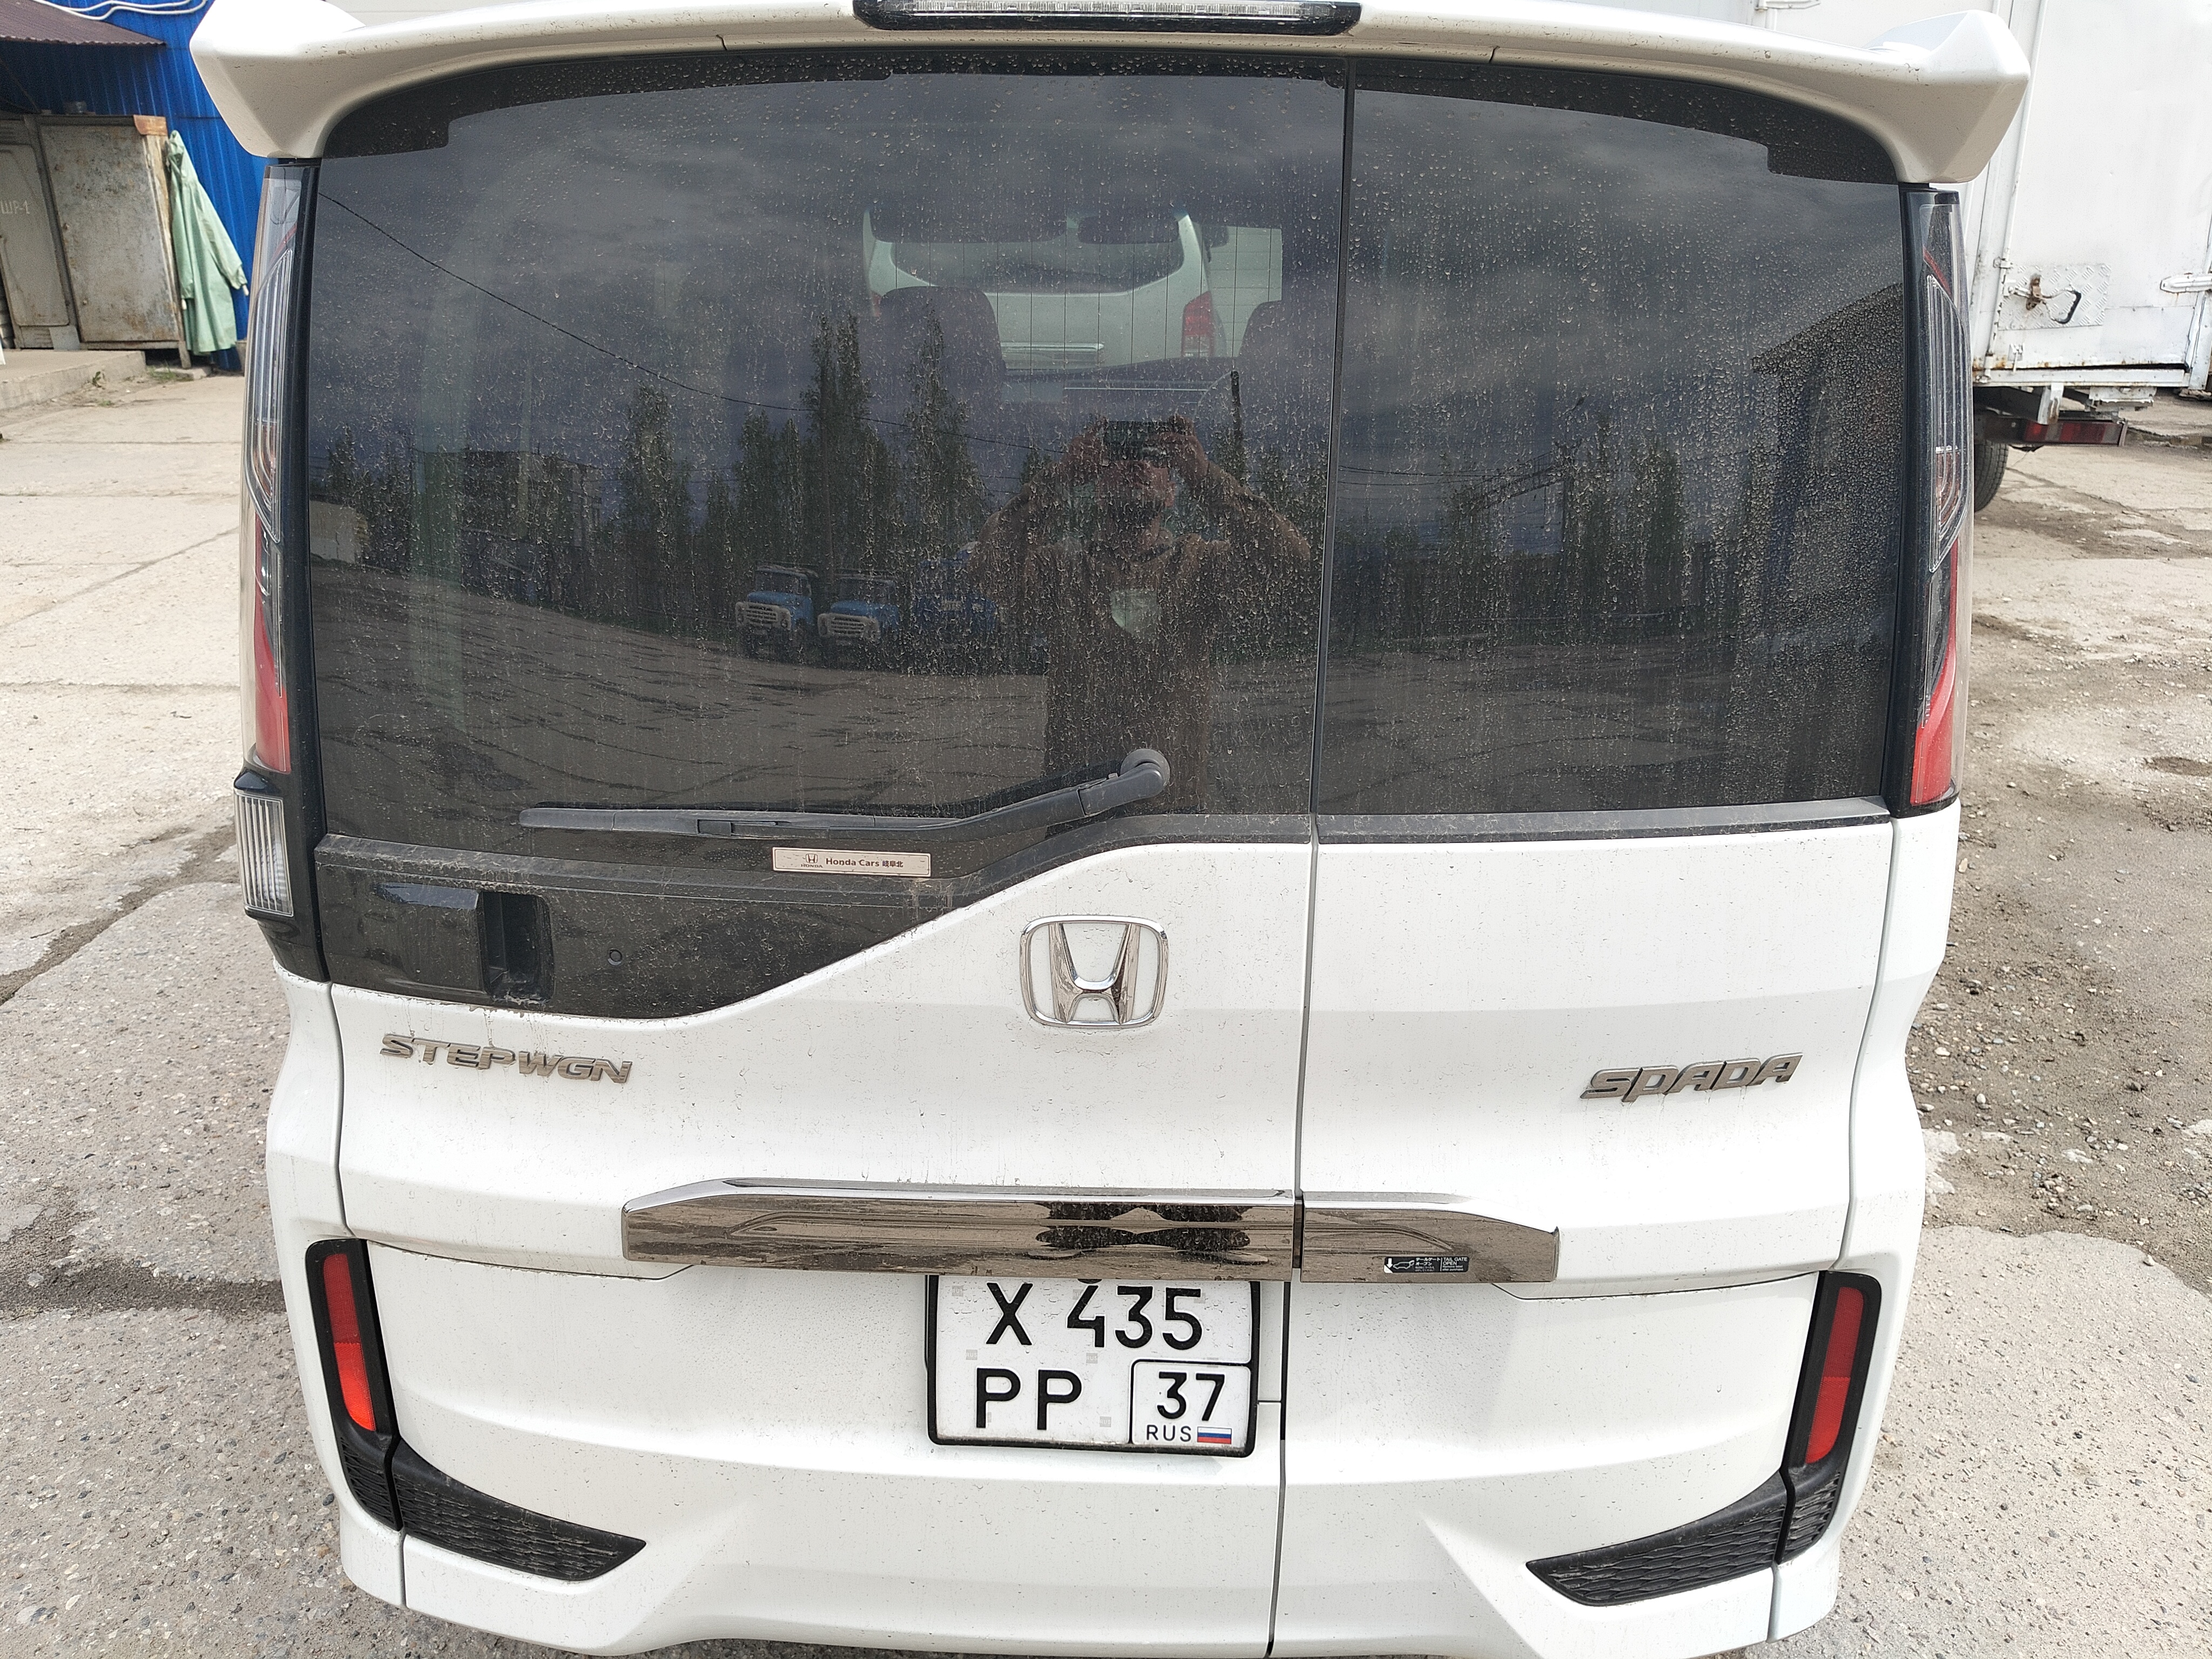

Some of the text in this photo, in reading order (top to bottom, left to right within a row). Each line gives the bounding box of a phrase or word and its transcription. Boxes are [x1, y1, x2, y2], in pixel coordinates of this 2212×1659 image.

[826, 858, 857, 866] Honda
[380, 1034, 633, 1084] STEPWGN
[1580, 1052, 1804, 1103] SPADA
[1067, 1285, 1203, 1350] 435
[1157, 1371, 1225, 1421] 37
[1146, 1424, 1191, 1442] RUS
